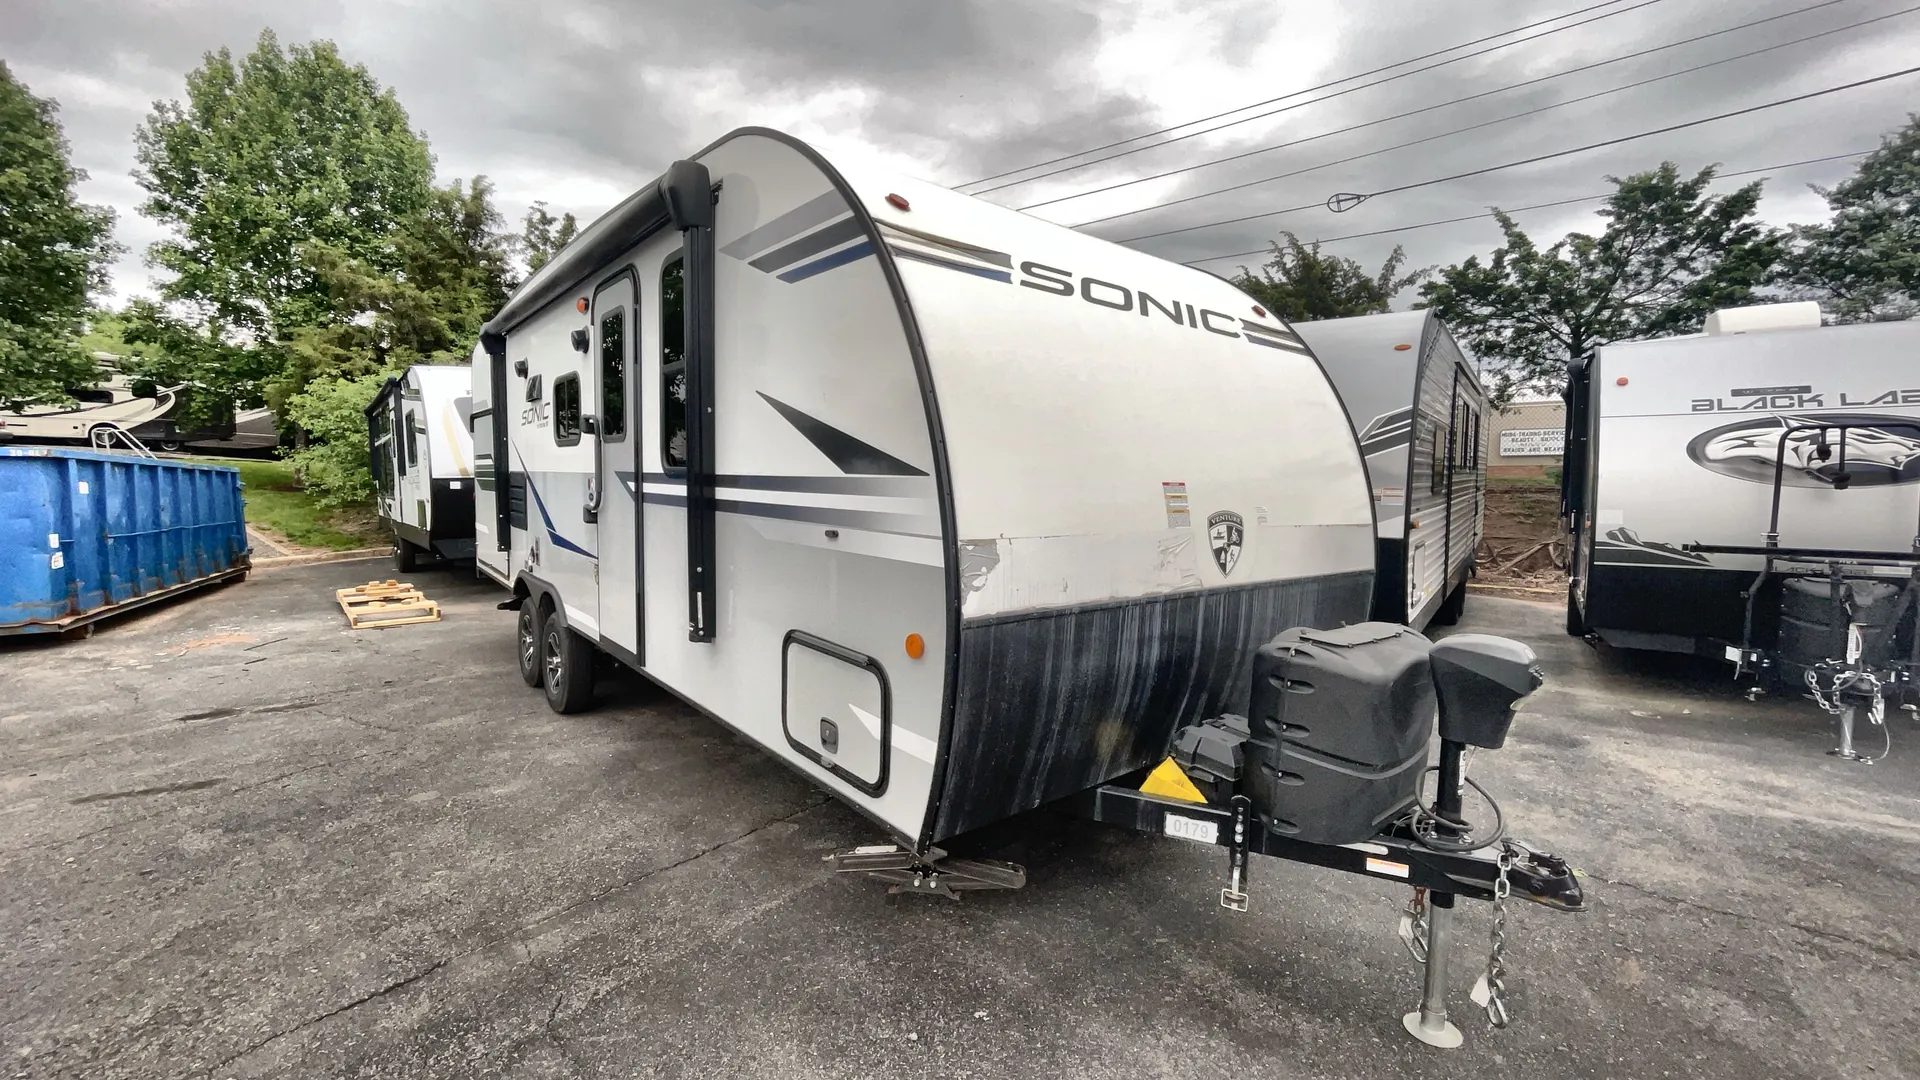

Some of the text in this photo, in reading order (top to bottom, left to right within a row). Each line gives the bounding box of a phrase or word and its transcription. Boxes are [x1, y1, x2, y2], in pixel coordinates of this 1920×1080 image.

[1020, 261, 1241, 339] SONIC
[1691, 393, 1825, 412] BLACK
[521, 402, 550, 426] SONIC
[1211, 515, 1242, 525] VENTURE
[1173, 819, 1209, 839] 0179
